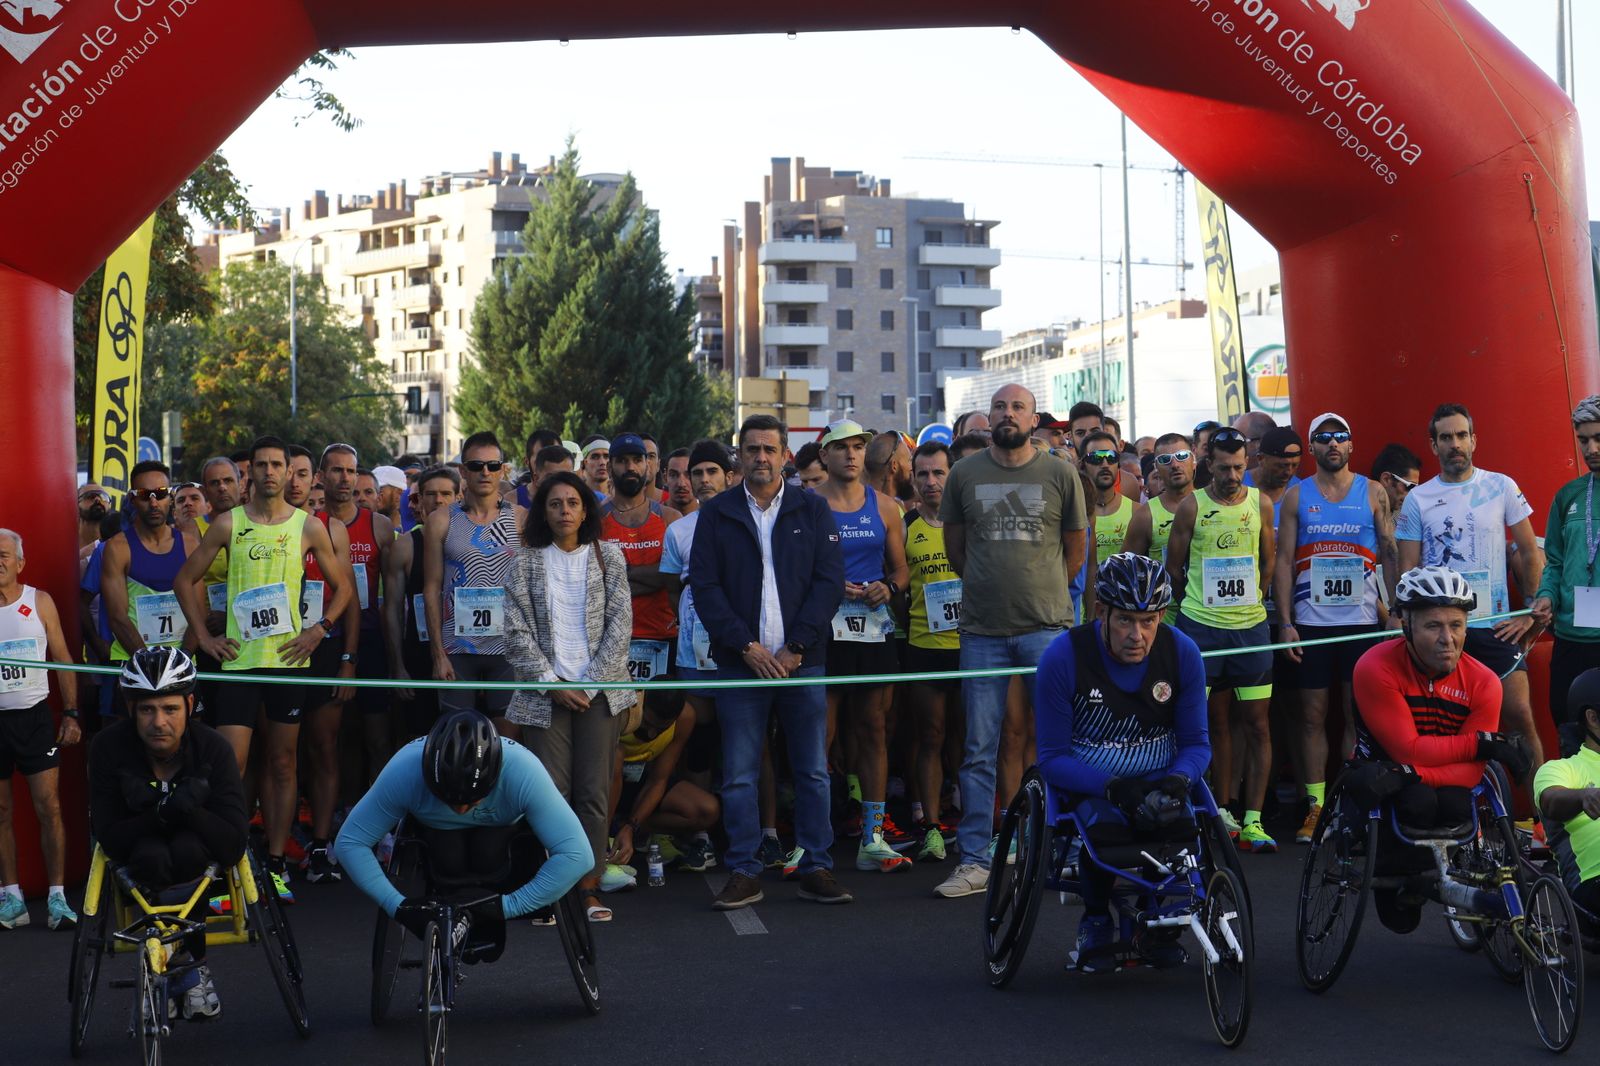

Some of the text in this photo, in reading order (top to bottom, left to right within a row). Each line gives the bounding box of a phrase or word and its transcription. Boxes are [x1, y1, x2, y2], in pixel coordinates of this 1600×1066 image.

[80, 25, 117, 61] de
[59, 105, 82, 128] de
[84, 27, 158, 104] Juventud
[157, 16, 171, 34] y
[1211, 11, 1235, 34] de
[1235, 34, 1313, 104] Juventud
[1306, 101, 1324, 116] y
[1323, 112, 1397, 184] Deportes
[1278, 29, 1313, 64] de
[1317, 60, 1421, 165] Córdoba
[1306, 522, 1362, 535] enerplus
[1313, 543, 1355, 553] Maratón
[912, 552, 948, 565] CLUB ATL
[1217, 579, 1245, 597] 348
[1324, 579, 1352, 597] 340
[158, 616, 173, 633] 71
[251, 607, 278, 629] 488
[473, 610, 491, 627] 20
[845, 616, 866, 633] 157
[1, 665, 26, 680] 581
[628, 660, 651, 679] 215
